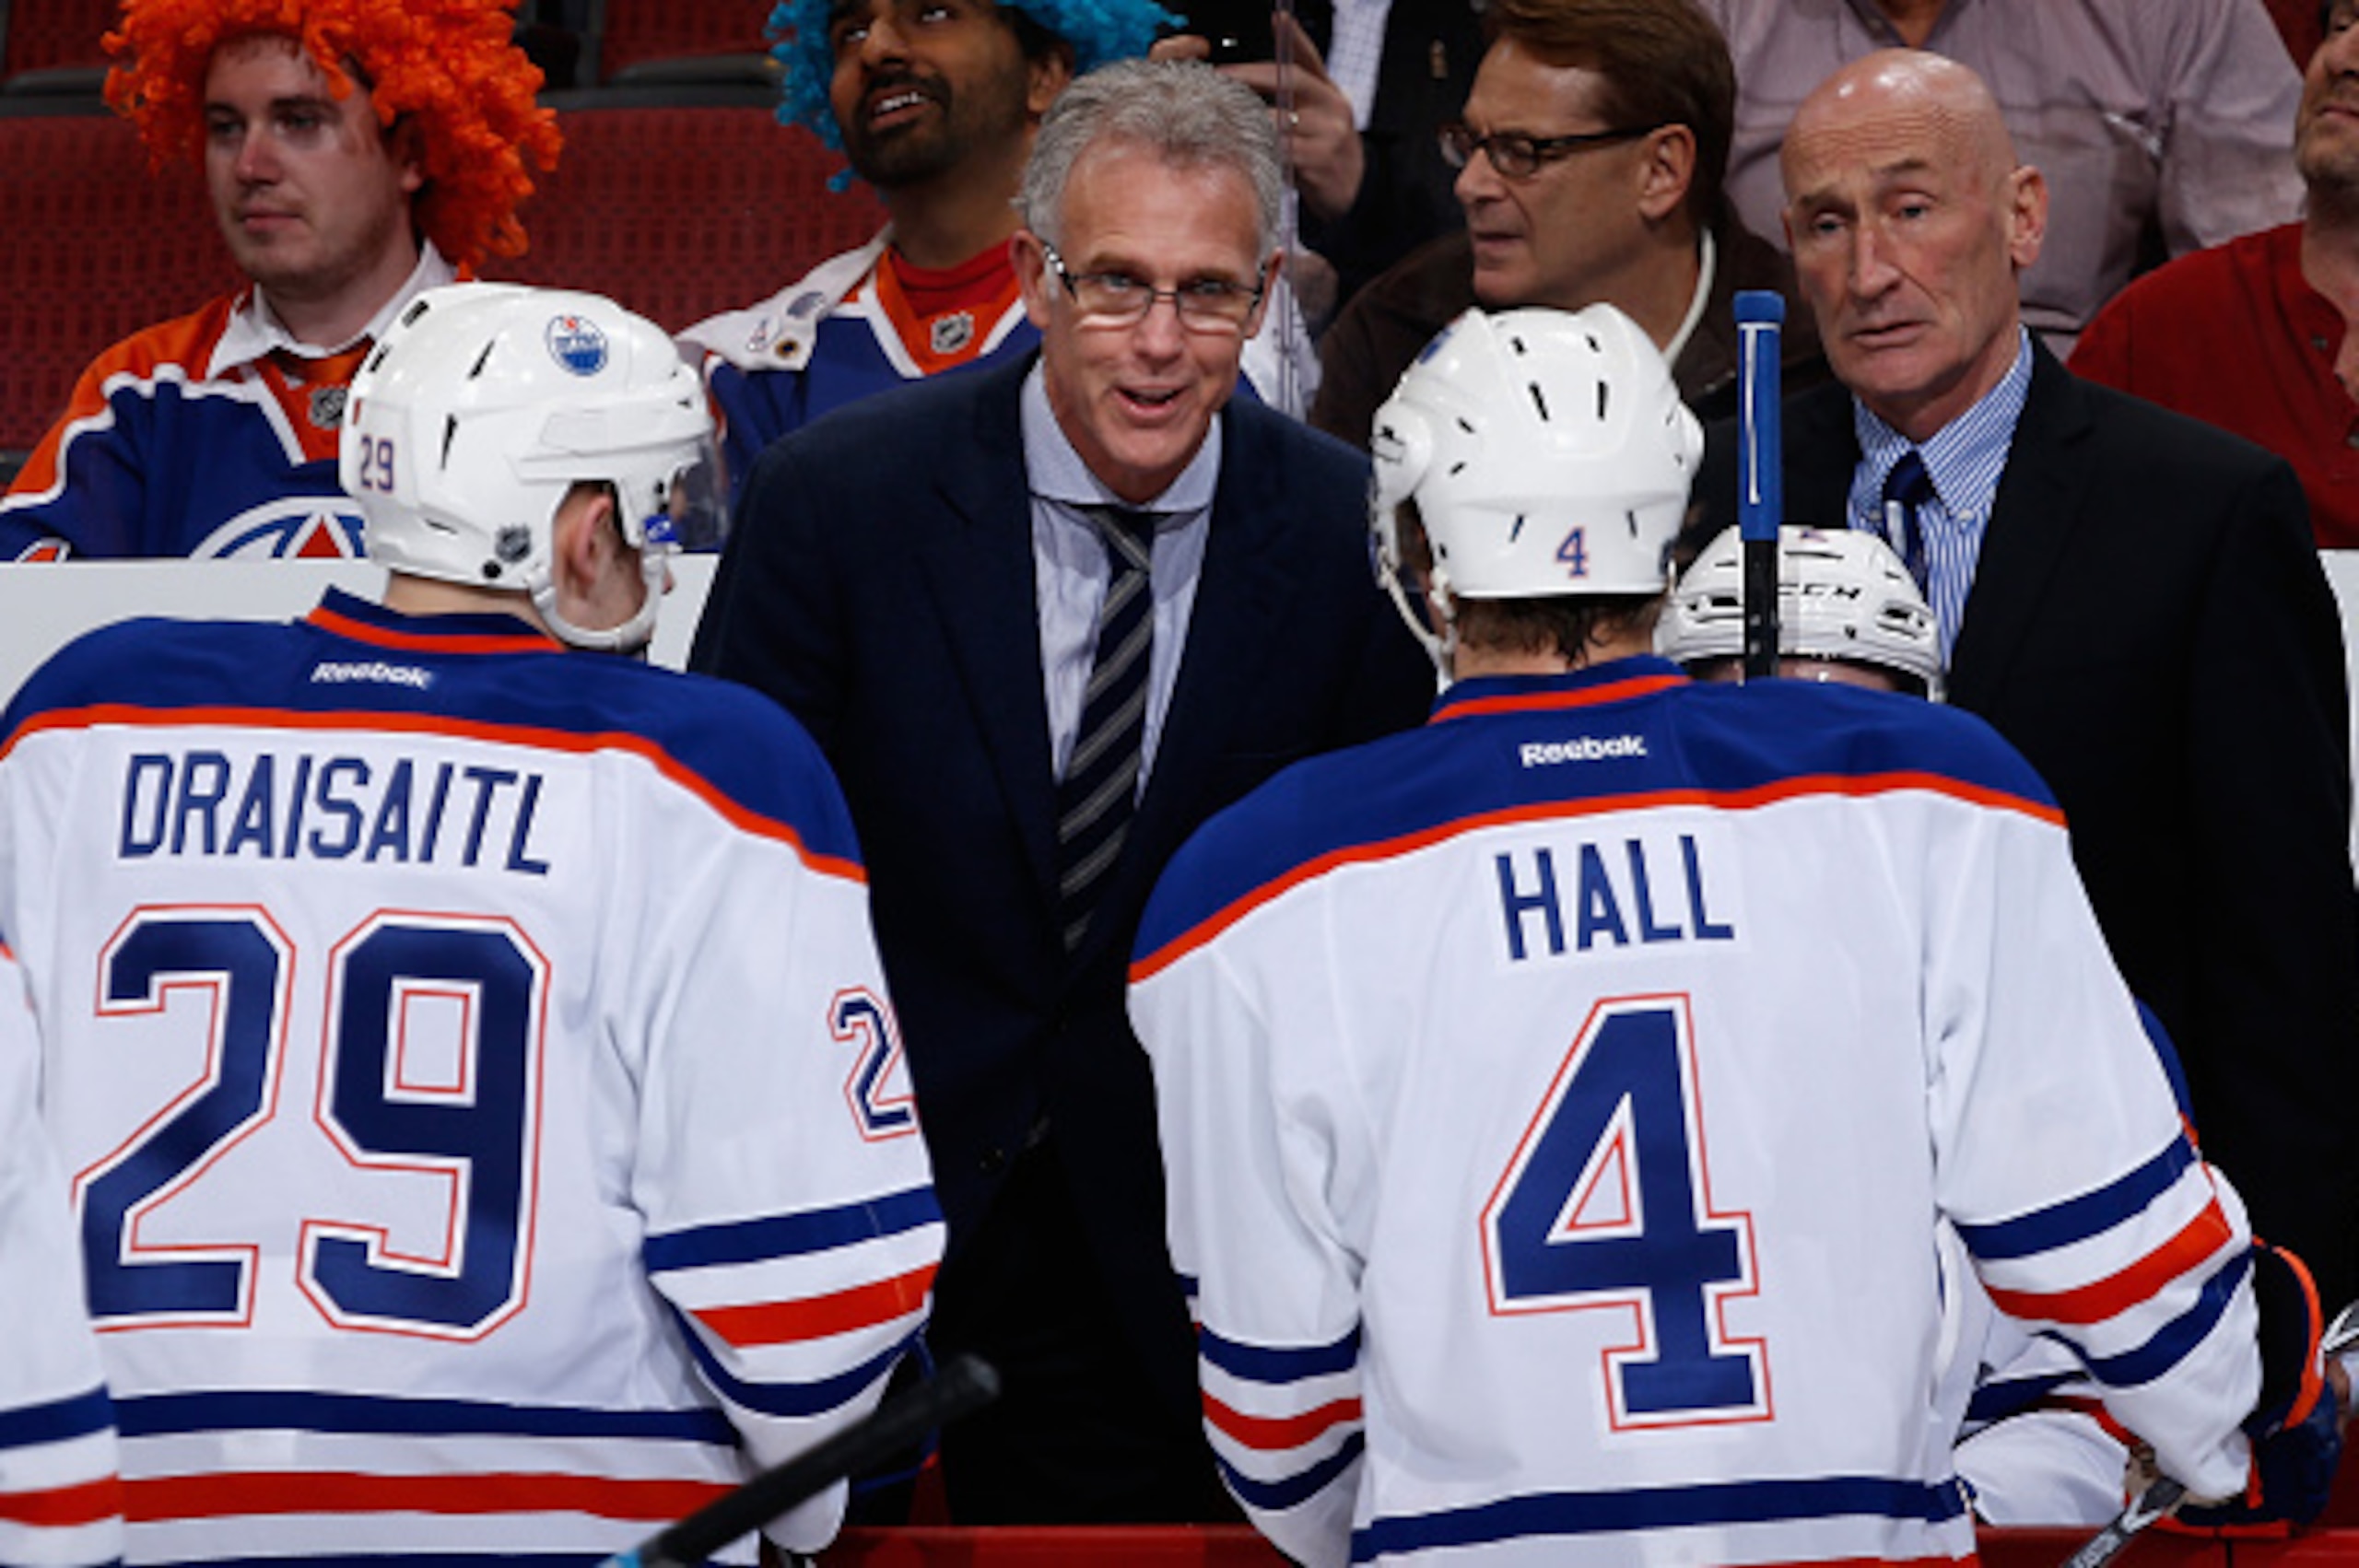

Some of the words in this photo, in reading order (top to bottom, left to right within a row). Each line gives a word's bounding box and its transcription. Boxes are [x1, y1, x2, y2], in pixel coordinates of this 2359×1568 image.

[360, 434, 393, 495] 29
[1553, 525, 1590, 579] 4
[311, 661, 433, 690] Reebok
[1520, 735, 1648, 767] Reebok
[120, 751, 550, 875] DRAISAITL
[1496, 835, 1735, 960] HALL
[71, 903, 553, 1343] 29
[1480, 992, 1775, 1433] 4
